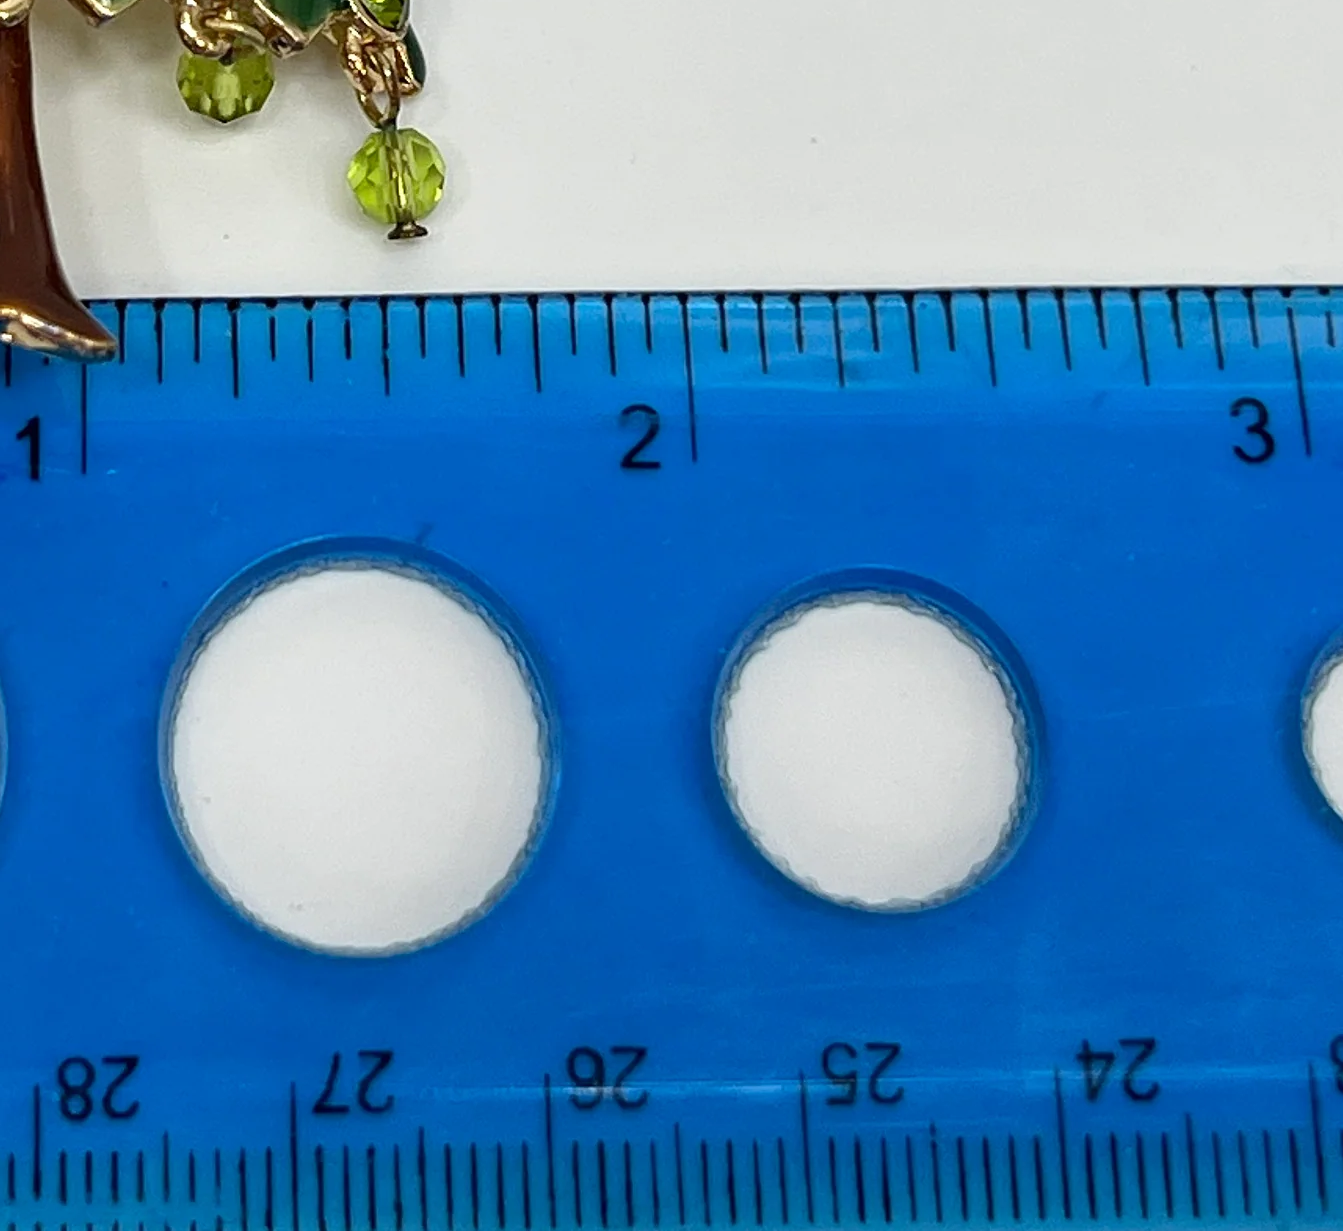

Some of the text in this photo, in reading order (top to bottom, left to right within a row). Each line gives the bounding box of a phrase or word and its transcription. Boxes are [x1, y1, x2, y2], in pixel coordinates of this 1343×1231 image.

[14, 414, 42, 482] 1
[618, 403, 663, 471] 2
[1229, 396, 1277, 465] 3
[56, 1054, 140, 1123] 28
[310, 1049, 395, 1117] 27
[565, 1045, 649, 1112] 26
[820, 1041, 904, 1107] 25
[1075, 1037, 1161, 1104] 24
